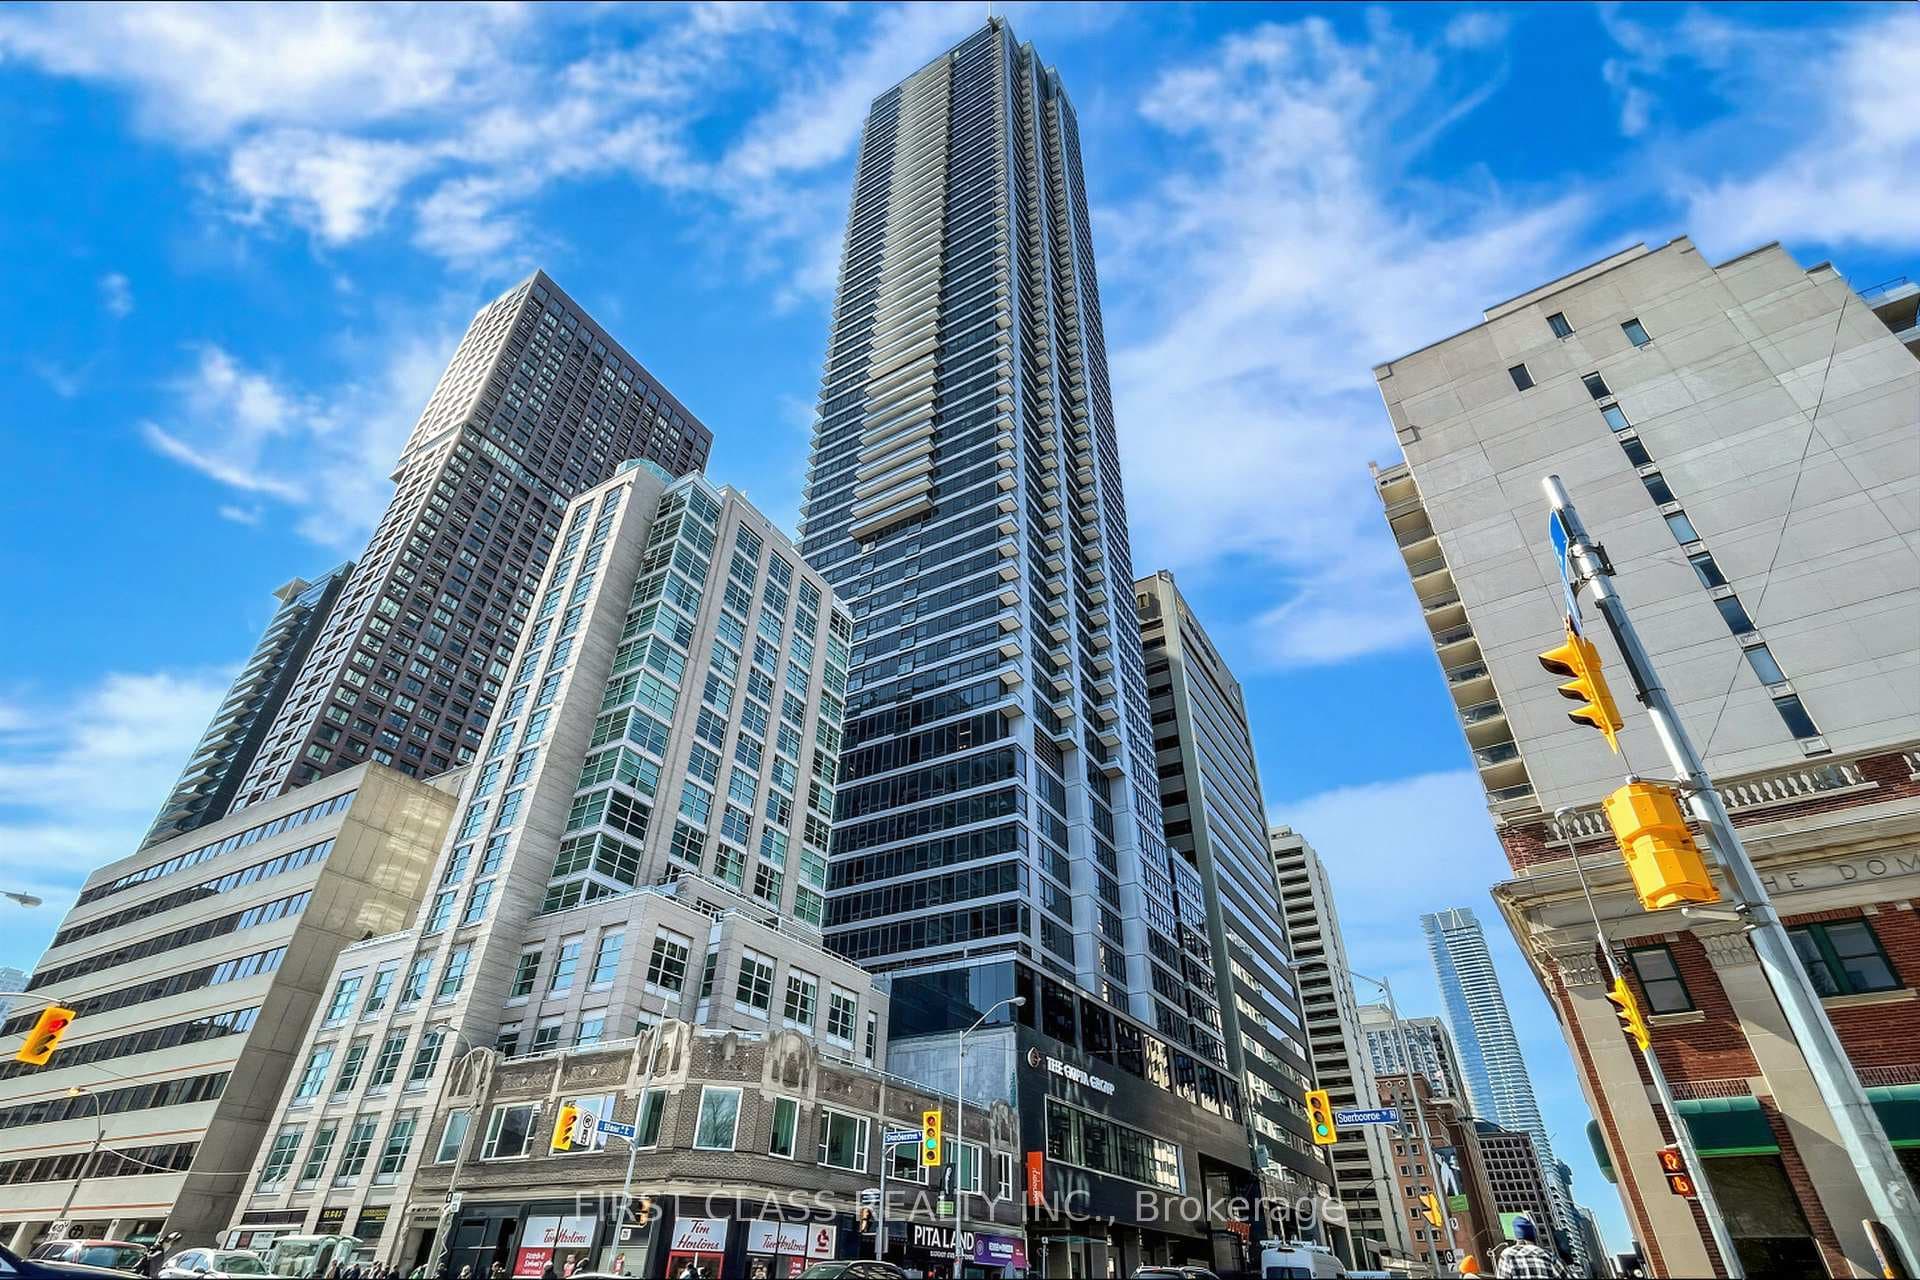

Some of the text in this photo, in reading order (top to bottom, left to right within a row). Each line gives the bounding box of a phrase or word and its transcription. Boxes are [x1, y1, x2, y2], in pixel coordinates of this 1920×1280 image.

[1760, 871, 1805, 893] HE
[1045, 1055, 1064, 1076] THE
[691, 1219, 710, 1234] Tim
[676, 1234, 720, 1250] Hortons
[914, 1225, 942, 1248] PITA
[942, 1228, 974, 1251] LAND
